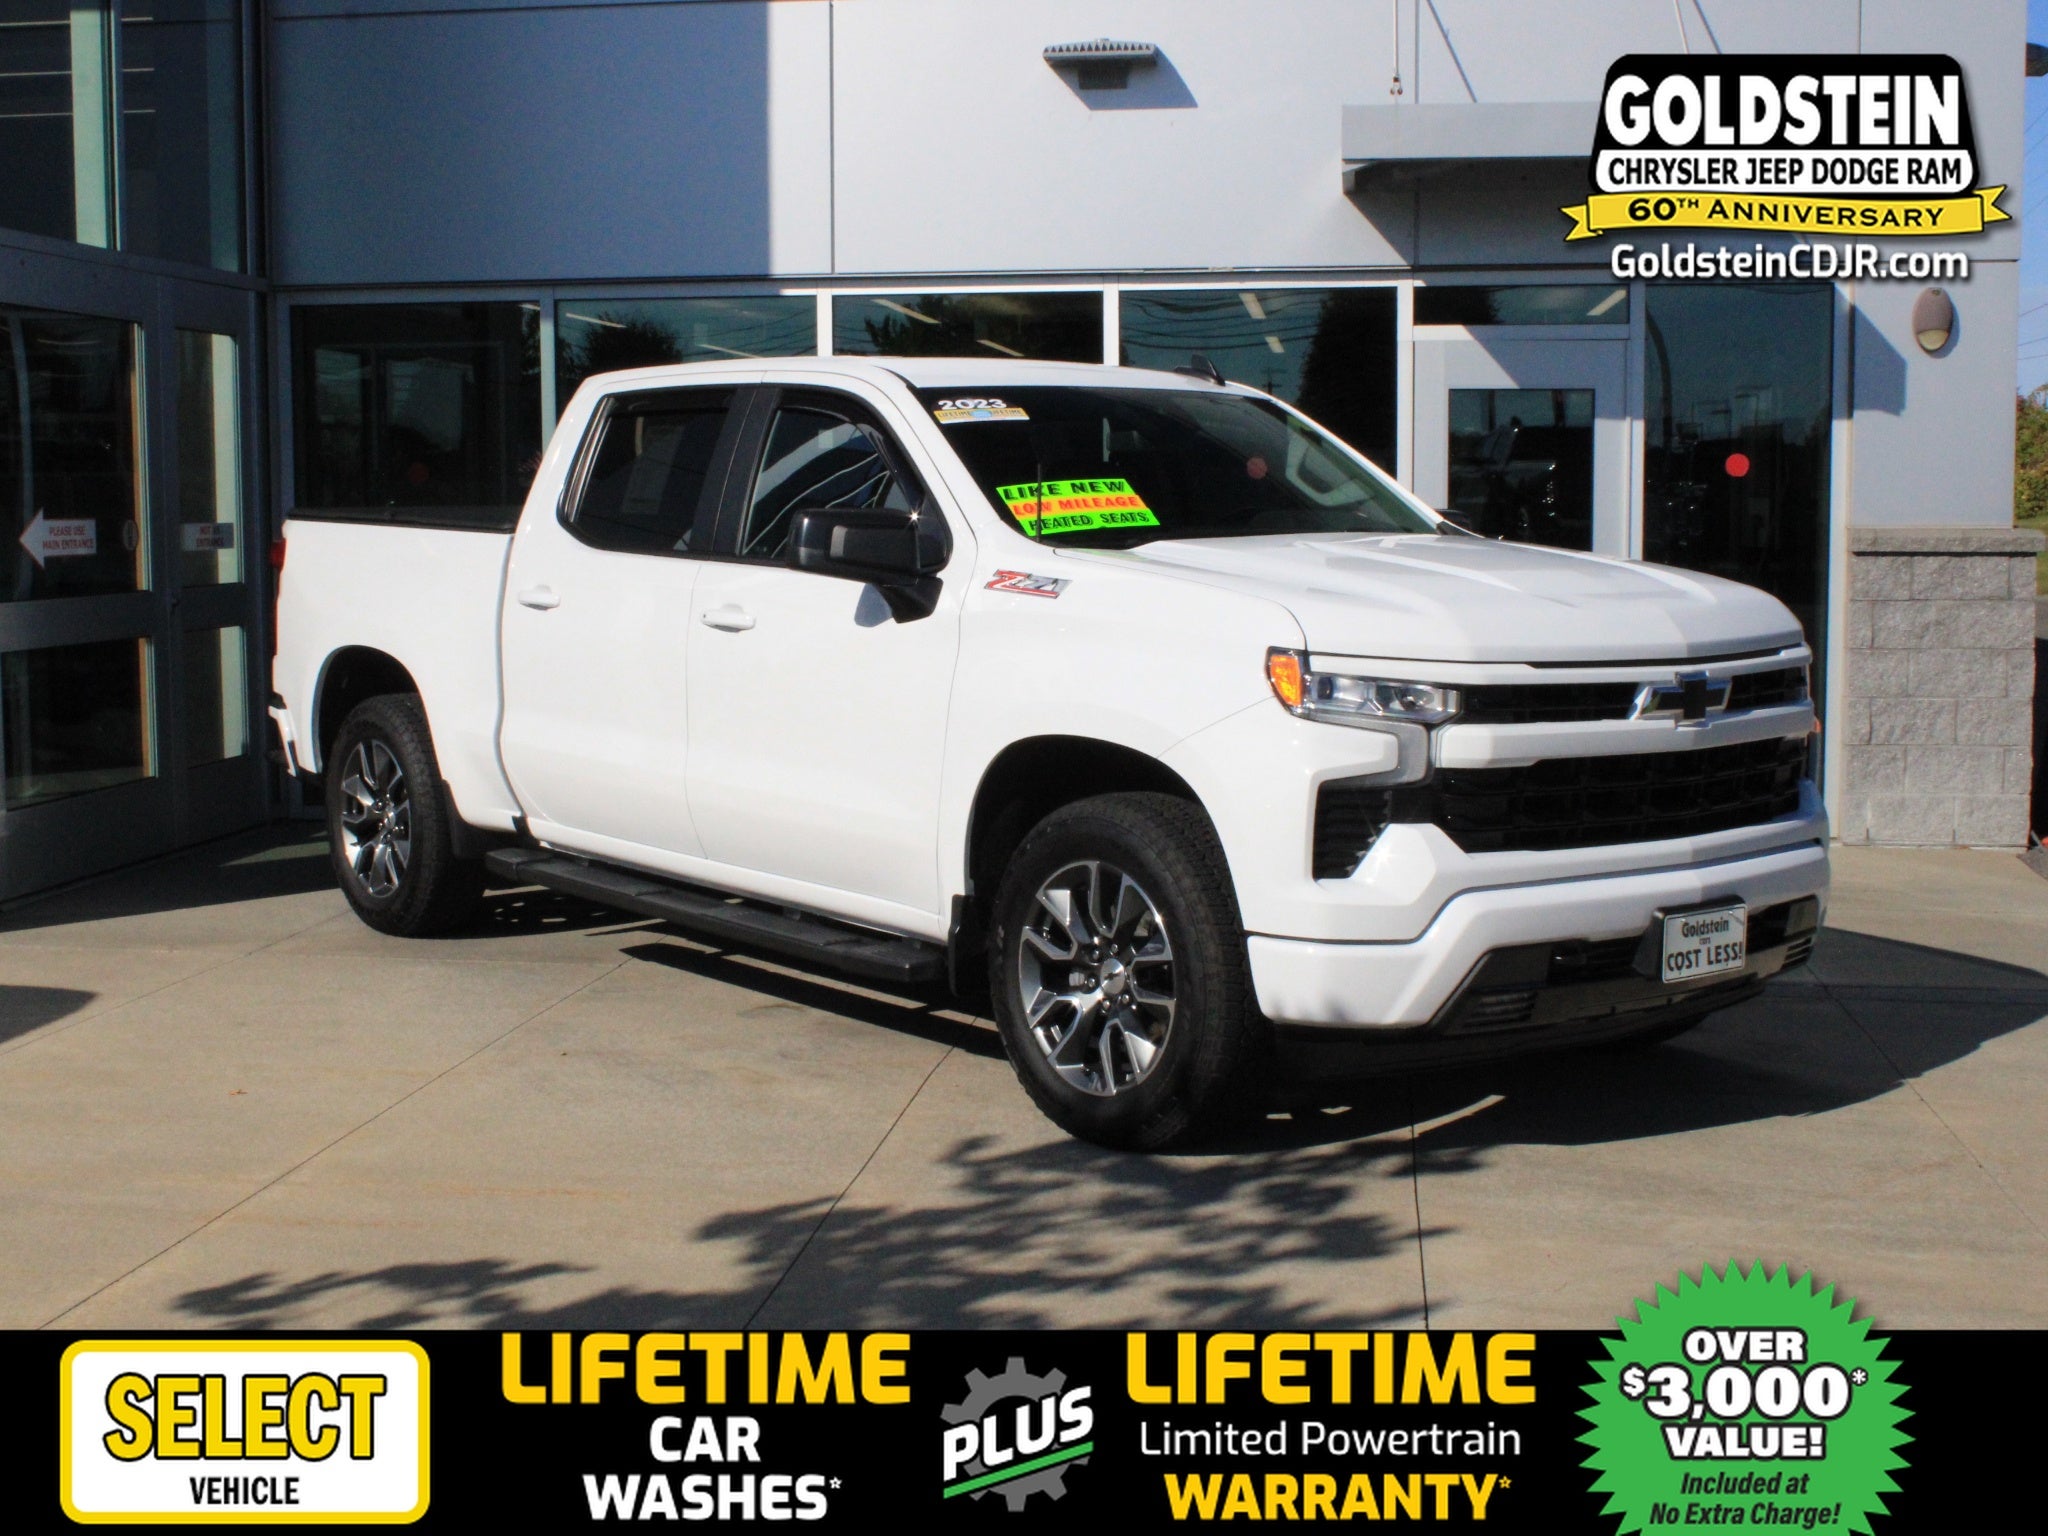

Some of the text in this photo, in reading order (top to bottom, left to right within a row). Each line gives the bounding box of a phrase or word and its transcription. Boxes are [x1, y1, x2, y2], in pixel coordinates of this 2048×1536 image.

[938, 399, 1007, 410] 2023
[1003, 481, 1124, 501] LIKE NEW
[1013, 496, 1140, 516] LOW MILEAGE
[49, 525, 73, 536] PLEASE
[1029, 511, 1149, 531] HEATED SEATS
[984, 569, 1072, 599] Z71
[1681, 919, 1729, 938] Goldstein
[1667, 941, 1743, 972] COST LESS!
